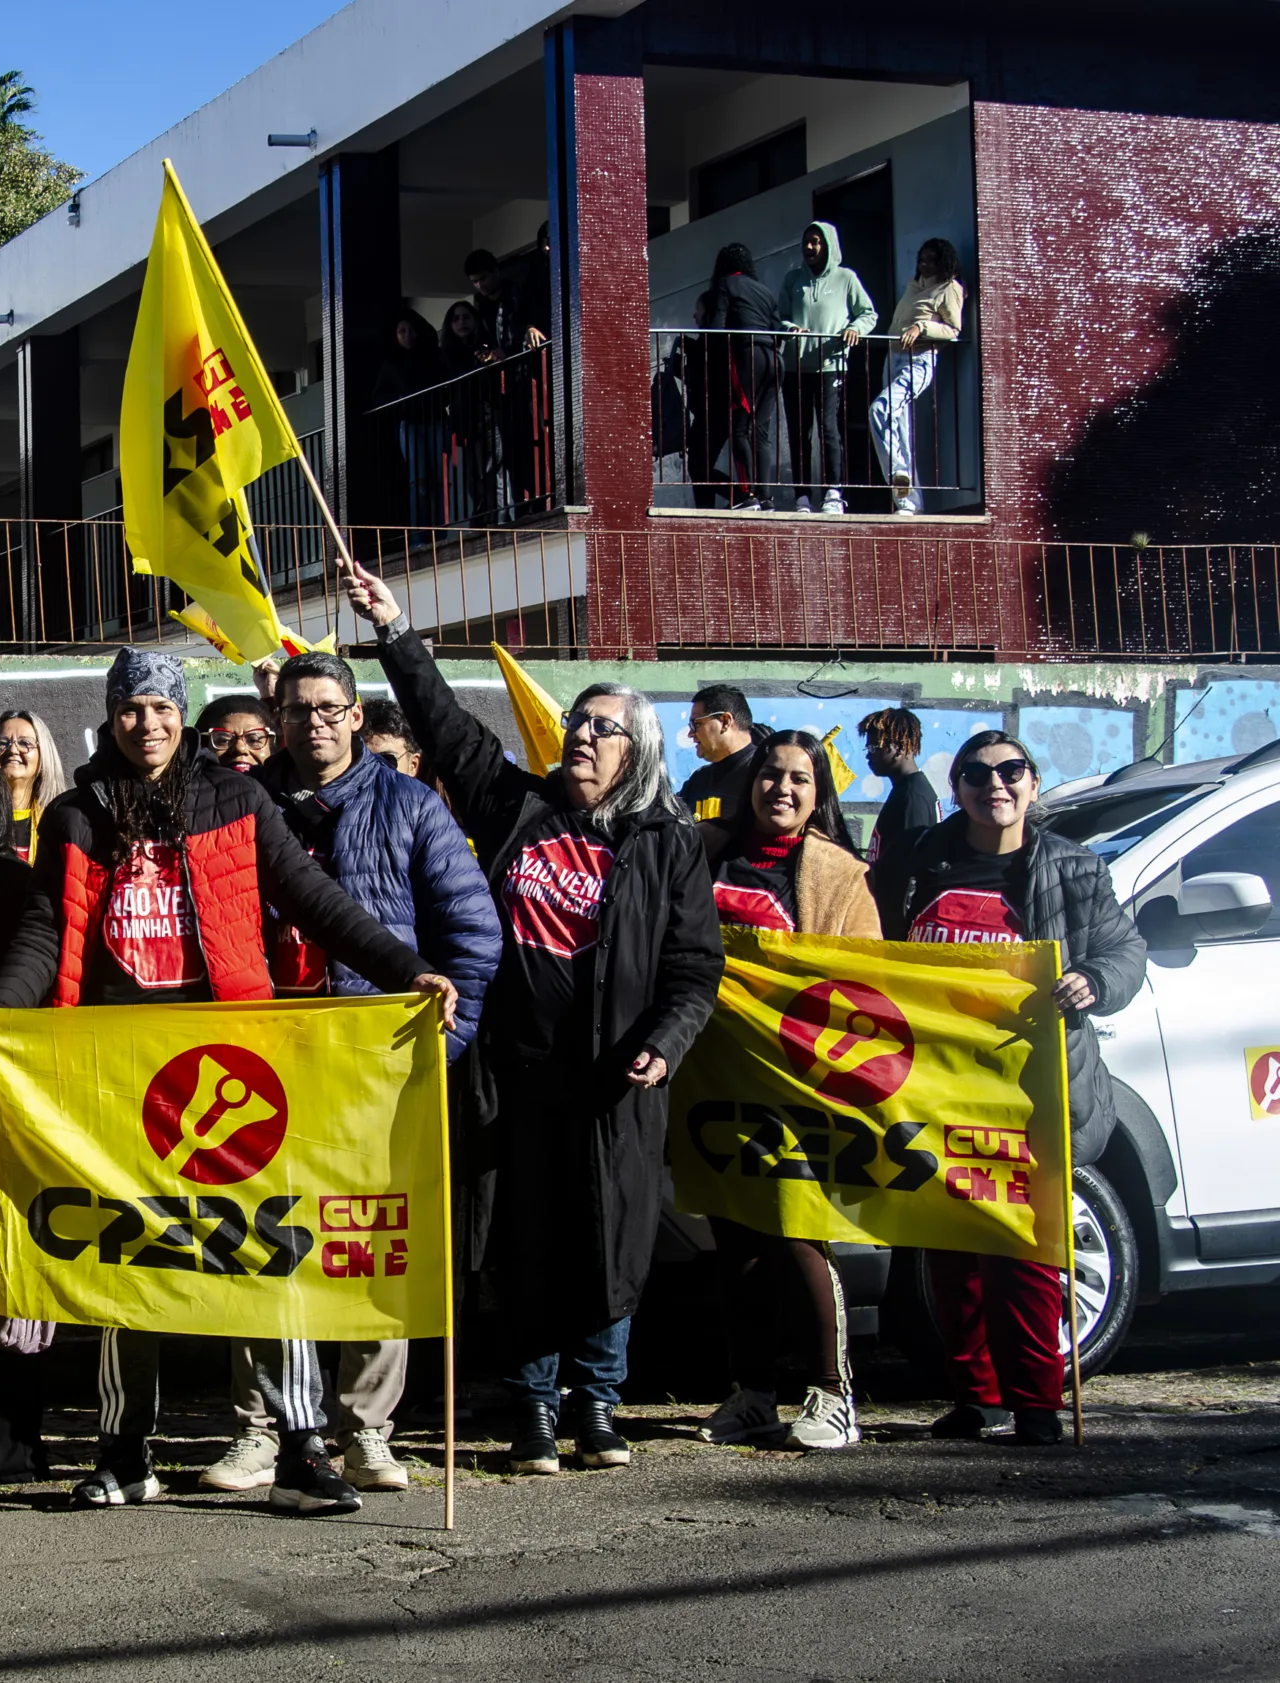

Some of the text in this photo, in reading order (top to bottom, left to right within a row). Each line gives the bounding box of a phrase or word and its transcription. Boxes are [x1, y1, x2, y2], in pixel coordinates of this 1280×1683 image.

[519, 854, 556, 883] NÃO
[108, 883, 150, 917] NÃO
[516, 876, 563, 908] MINHA
[109, 920, 119, 939] A
[122, 917, 172, 938] MINHA
[688, 1099, 939, 1192] CPERS
[947, 1127, 1028, 1161] CUT
[321, 1197, 406, 1230] CUT
[27, 1186, 314, 1277] CPERS
